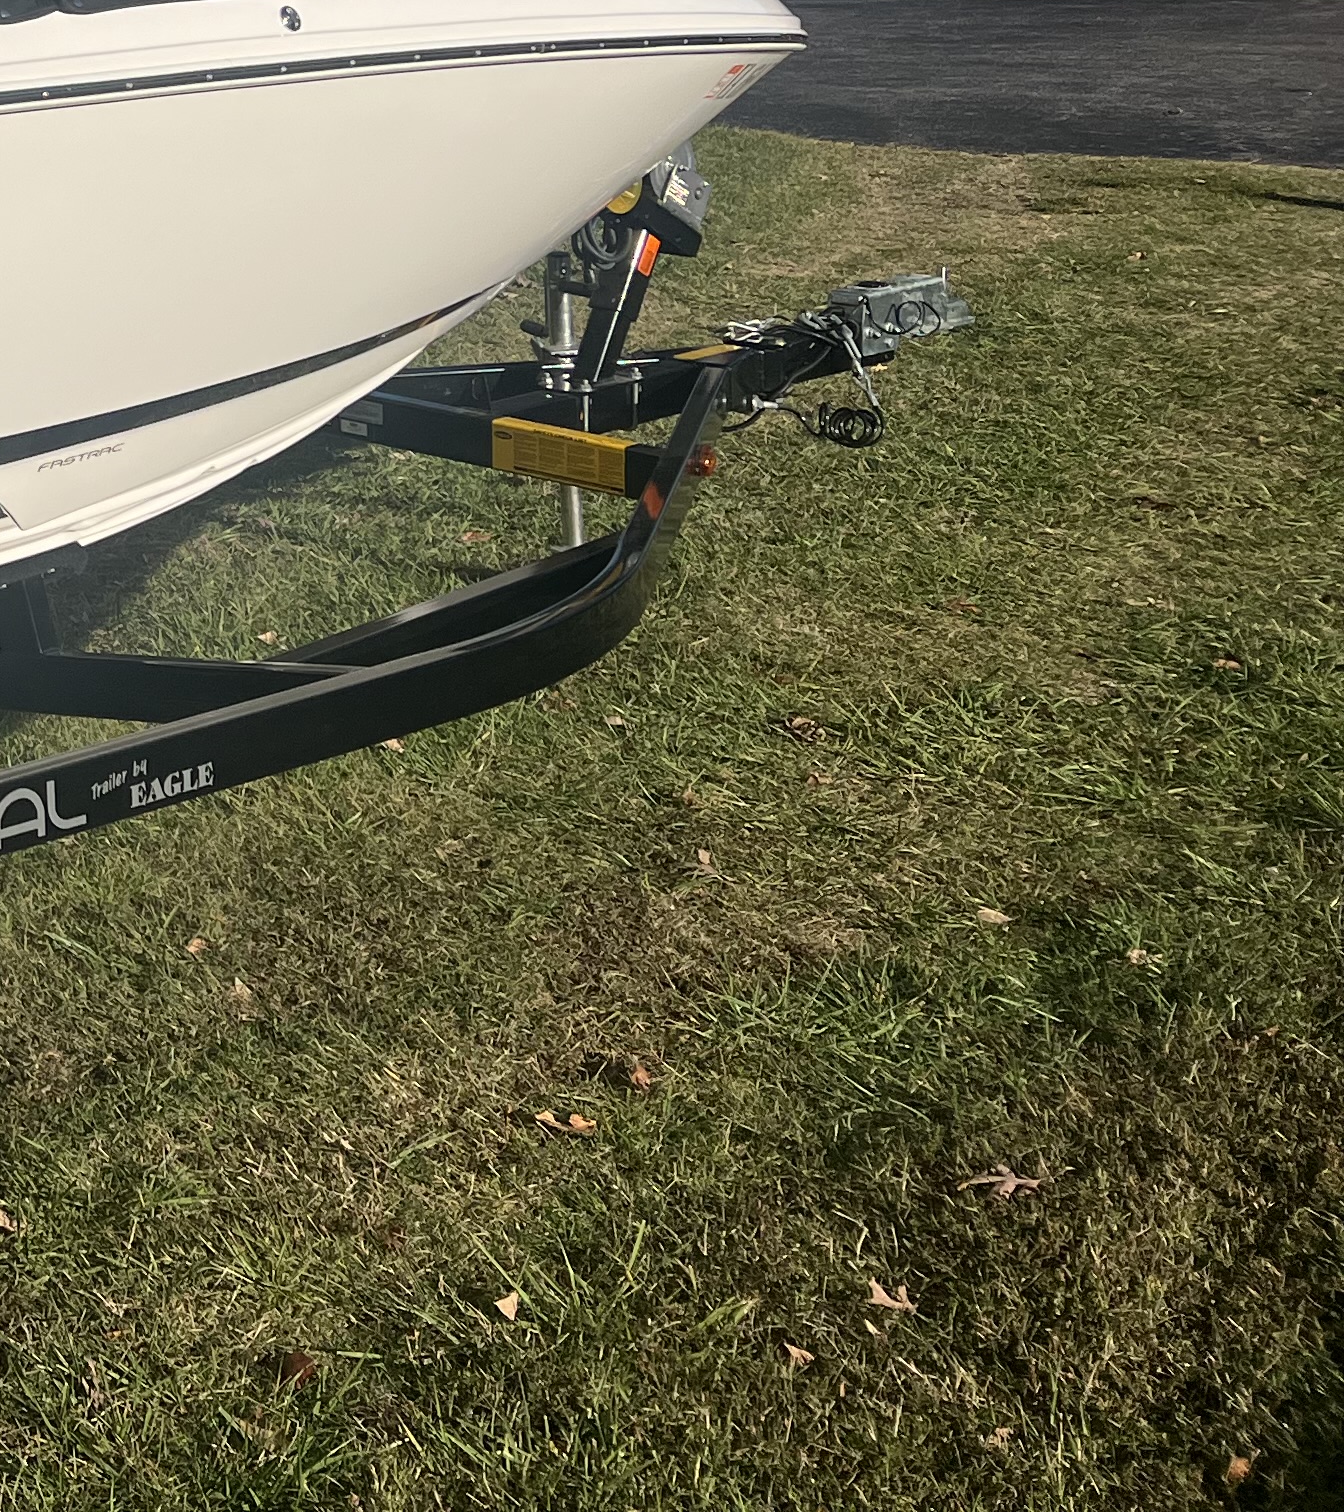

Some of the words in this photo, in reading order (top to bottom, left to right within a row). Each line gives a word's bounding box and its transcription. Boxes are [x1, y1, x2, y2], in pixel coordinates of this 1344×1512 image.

[37, 442, 125, 473] FASTRAC
[91, 770, 128, 800] Trailer
[132, 758, 148, 777] by
[130, 761, 215, 809] EAGLE
